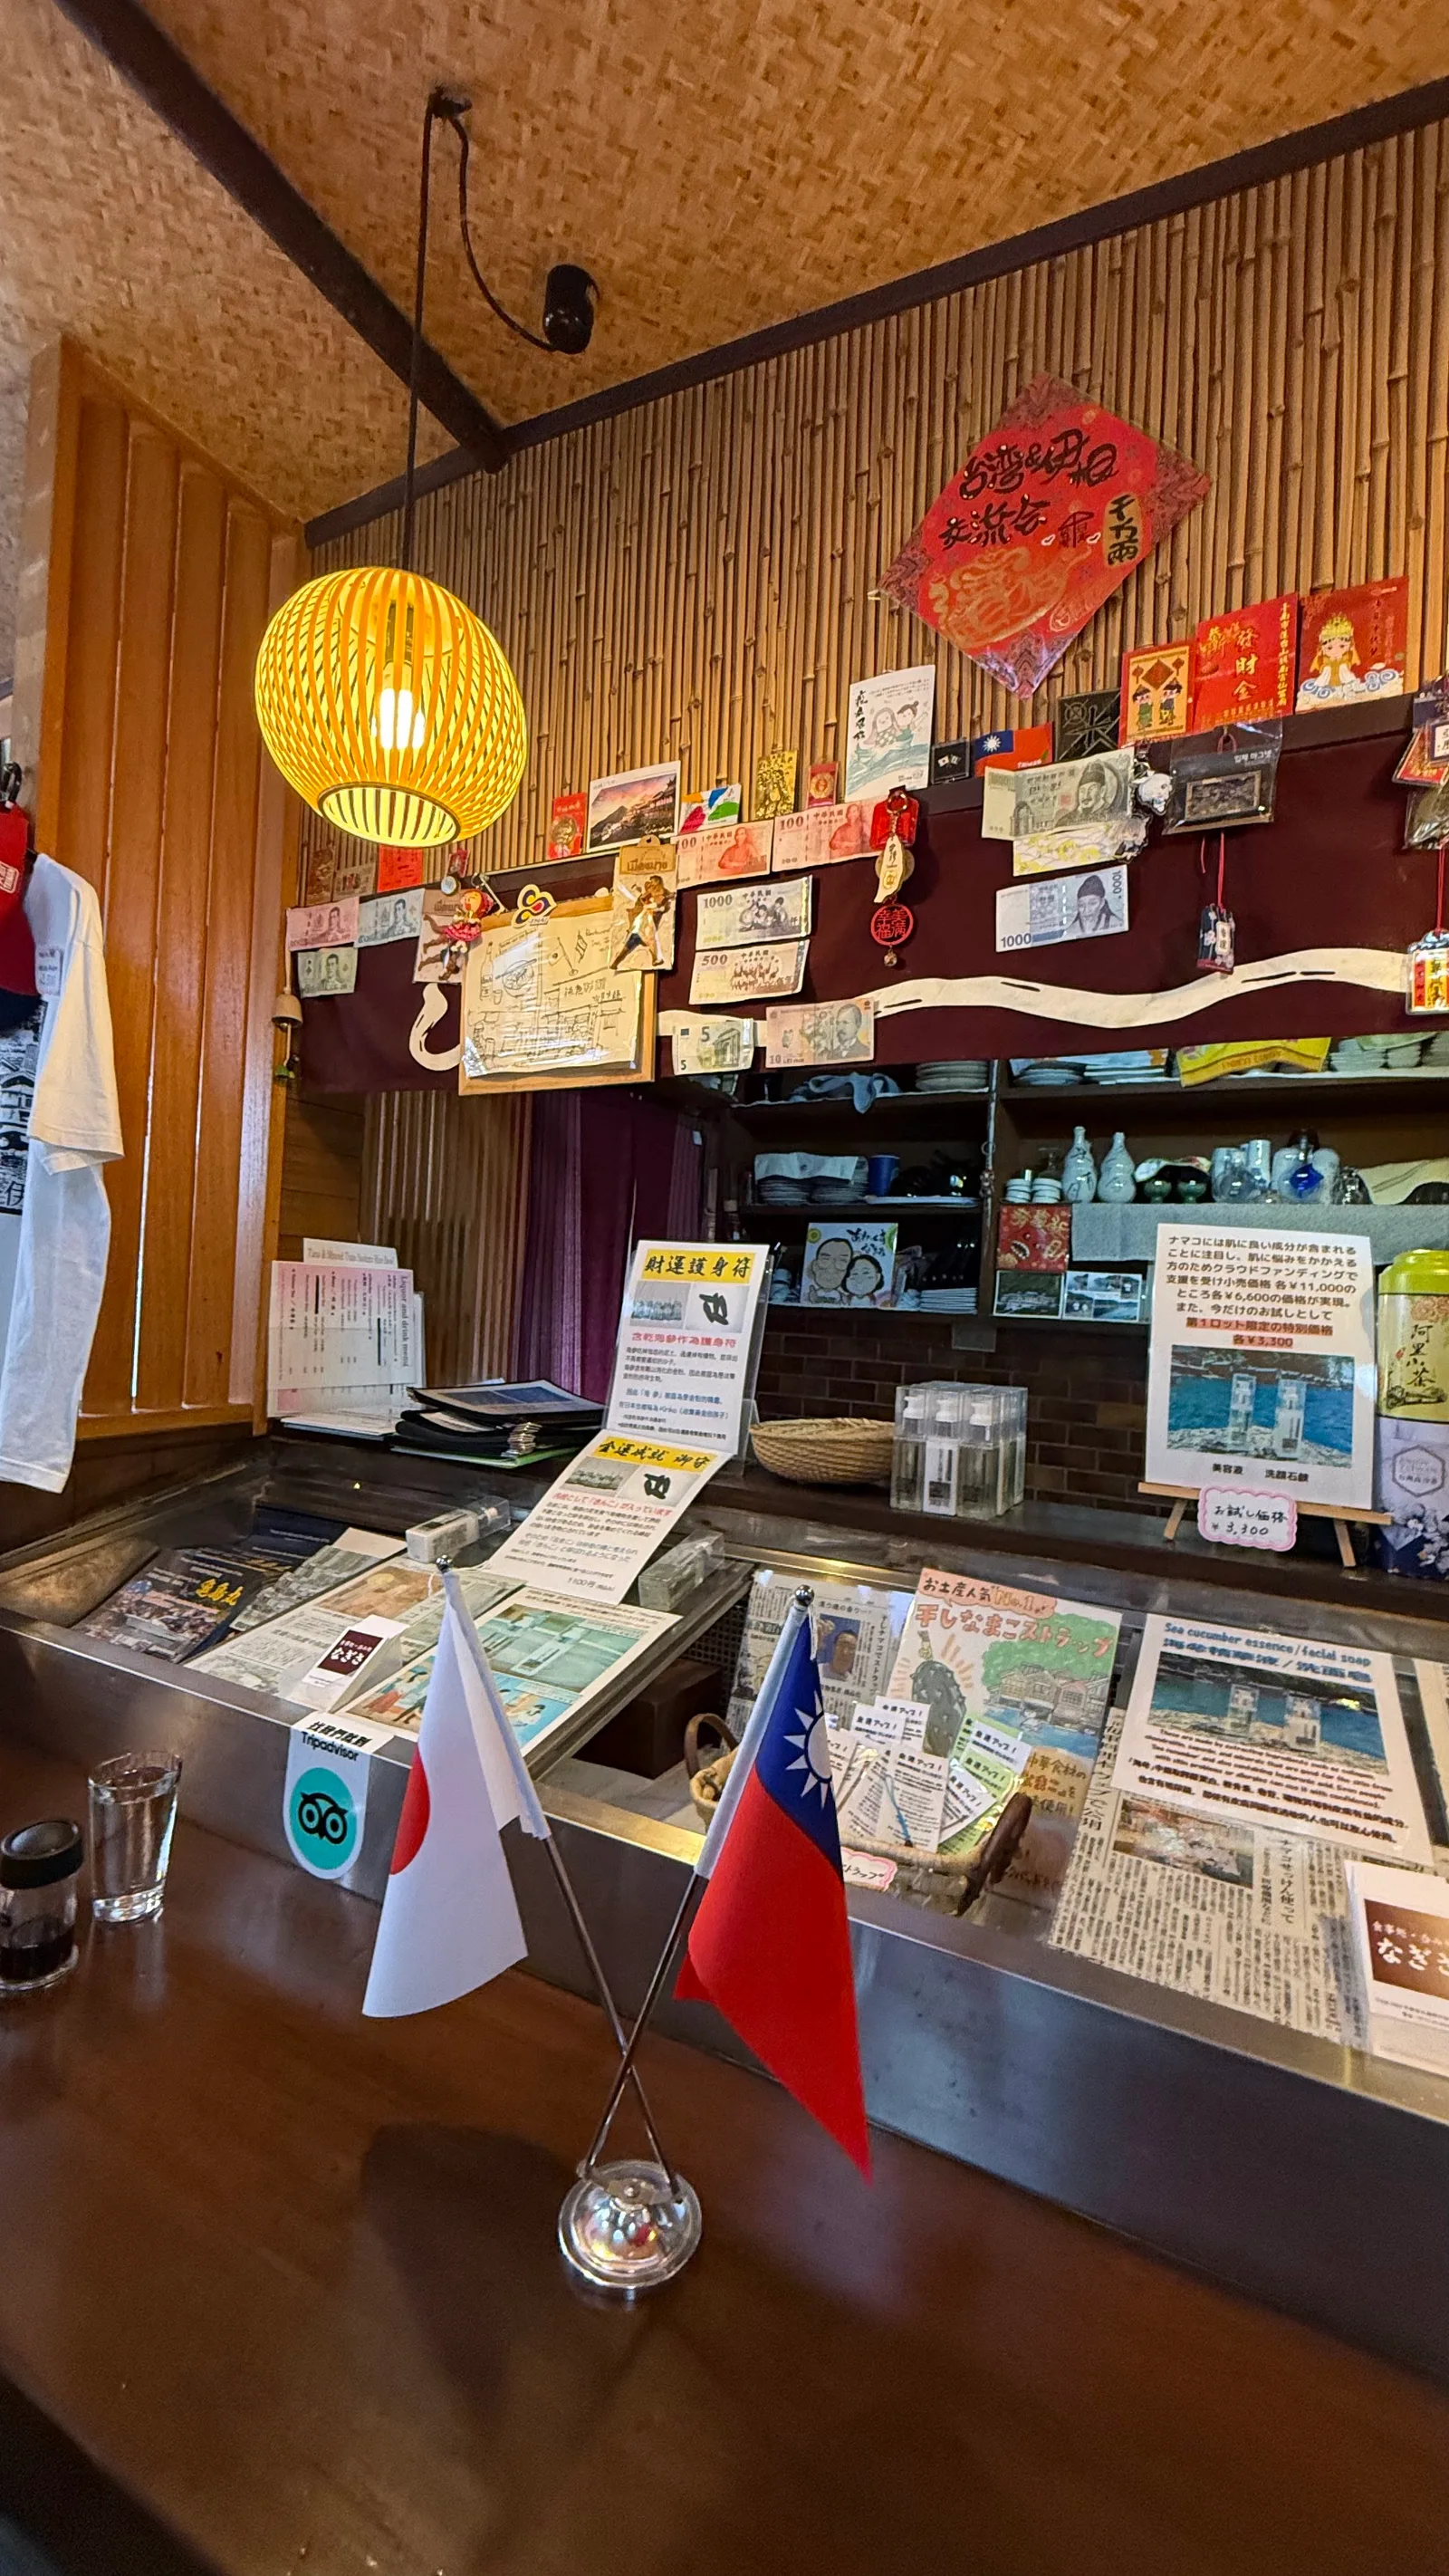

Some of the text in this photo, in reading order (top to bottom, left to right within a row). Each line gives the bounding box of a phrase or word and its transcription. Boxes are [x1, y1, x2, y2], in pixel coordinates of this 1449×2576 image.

[939, 494, 1051, 551] 交流会
[781, 816, 803, 830] 100
[1112, 870, 1122, 894] 1000
[703, 894, 733, 908] 1000
[1001, 933, 1032, 947] 1000
[702, 955, 728, 966] 500
[701, 1026, 710, 1042] 5
[680, 1060, 687, 1071] 5
[770, 1054, 782, 1064] 10
[1168, 1236, 1357, 1255] ナマコには肌に良い成分が含まれる
[645, 1254, 752, 1278] 財運護身符
[1166, 1262, 1358, 1281] 方のためクラウドファンディングで
[1166, 1274, 1271, 1290] 支援を受け小売価格
[1213, 1464, 1243, 1475] 美容液
[1214, 1504, 1287, 1523] お試し価格
[923, 1577, 991, 1601] お土産人気
[916, 1603, 1113, 1658] 干しなまこストラップ
[1165, 1622, 1185, 1634] Sea
[1187, 1629, 1242, 1644] cucumber
[1341, 1655, 1371, 1667] soap
[331, 1647, 364, 1665] なぎさ
[301, 1731, 359, 1761] Tripadvisor
